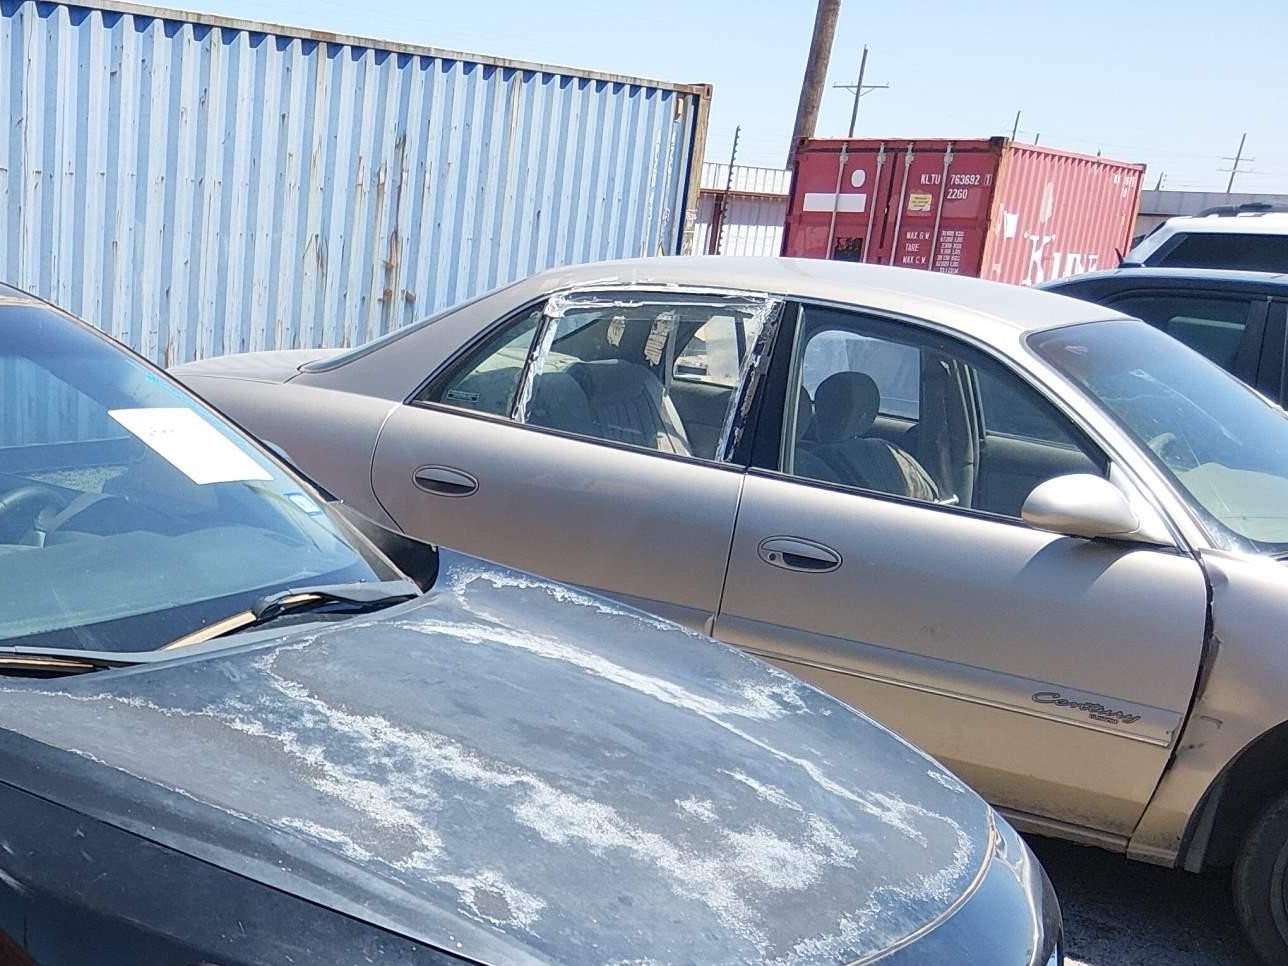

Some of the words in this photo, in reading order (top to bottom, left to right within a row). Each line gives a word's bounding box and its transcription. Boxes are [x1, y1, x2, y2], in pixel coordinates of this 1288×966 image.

[920, 174, 942, 185] KLTU
[950, 174, 980, 186] 763692
[947, 188, 968, 200] 2260
[1032, 692, 1141, 724] Century
